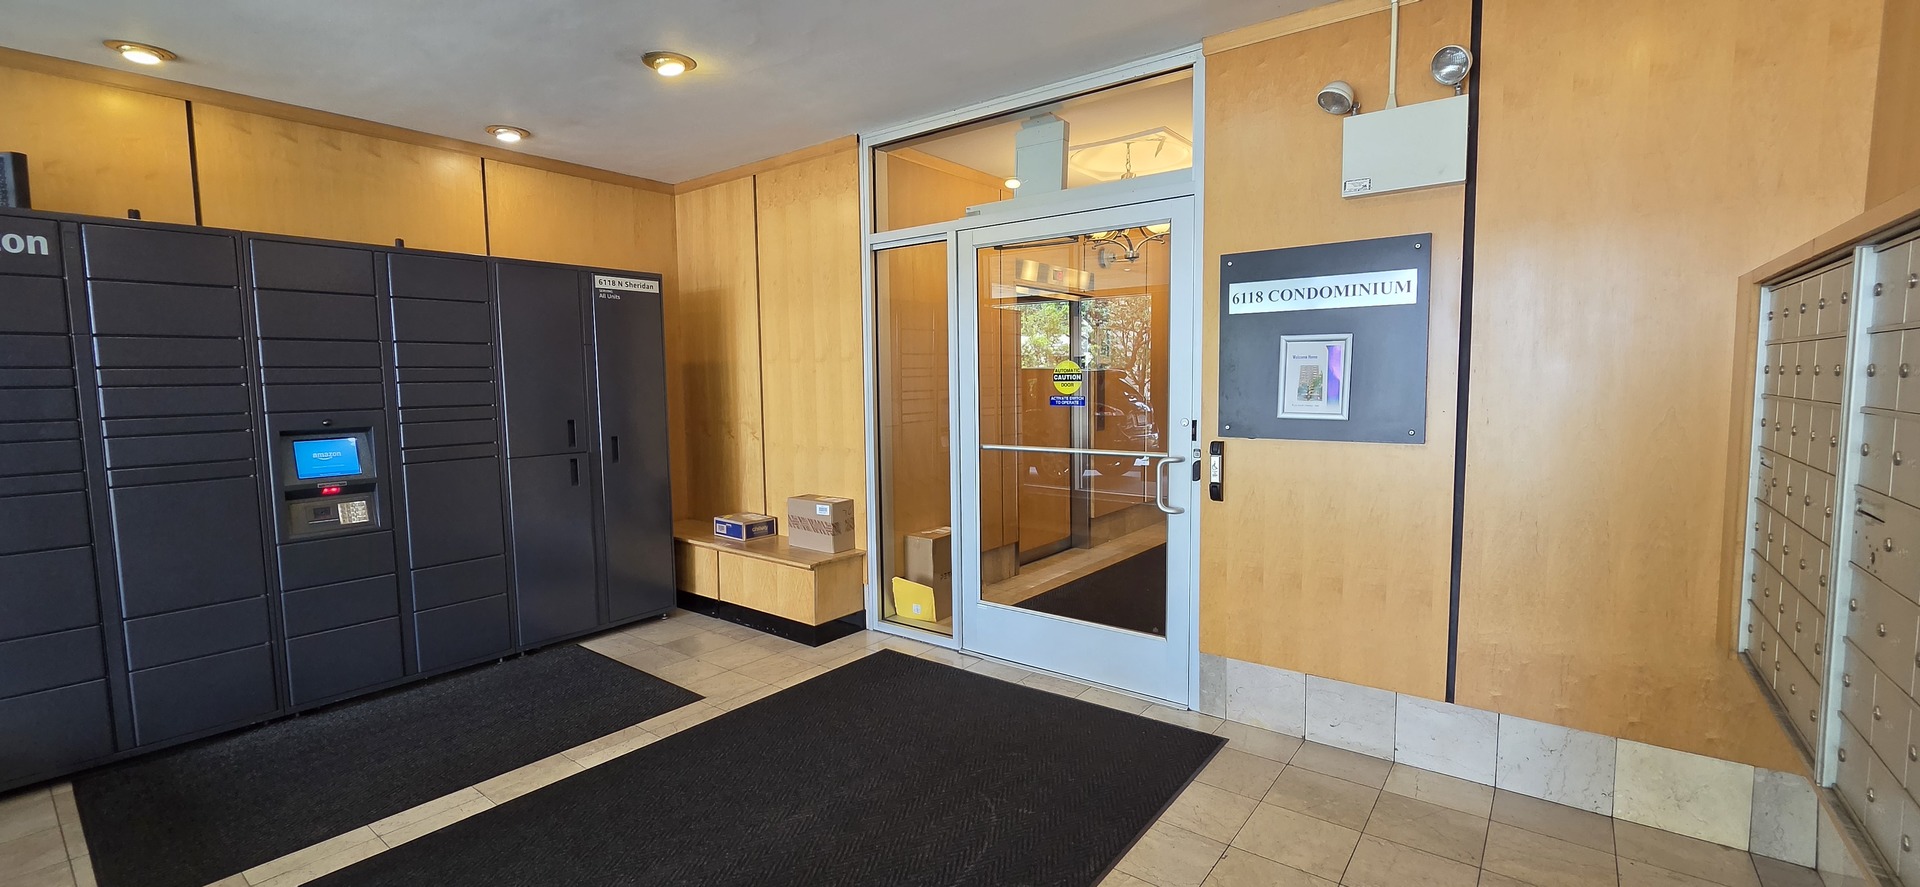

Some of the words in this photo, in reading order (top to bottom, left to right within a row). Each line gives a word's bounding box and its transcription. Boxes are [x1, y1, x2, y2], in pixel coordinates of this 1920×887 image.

[598, 279, 616, 287] 6118
[625, 281, 654, 290] Sheridan
[1231, 290, 1264, 305] 6118
[1268, 280, 1412, 303] CONDOMINIUM
[312, 451, 342, 459] amazon
